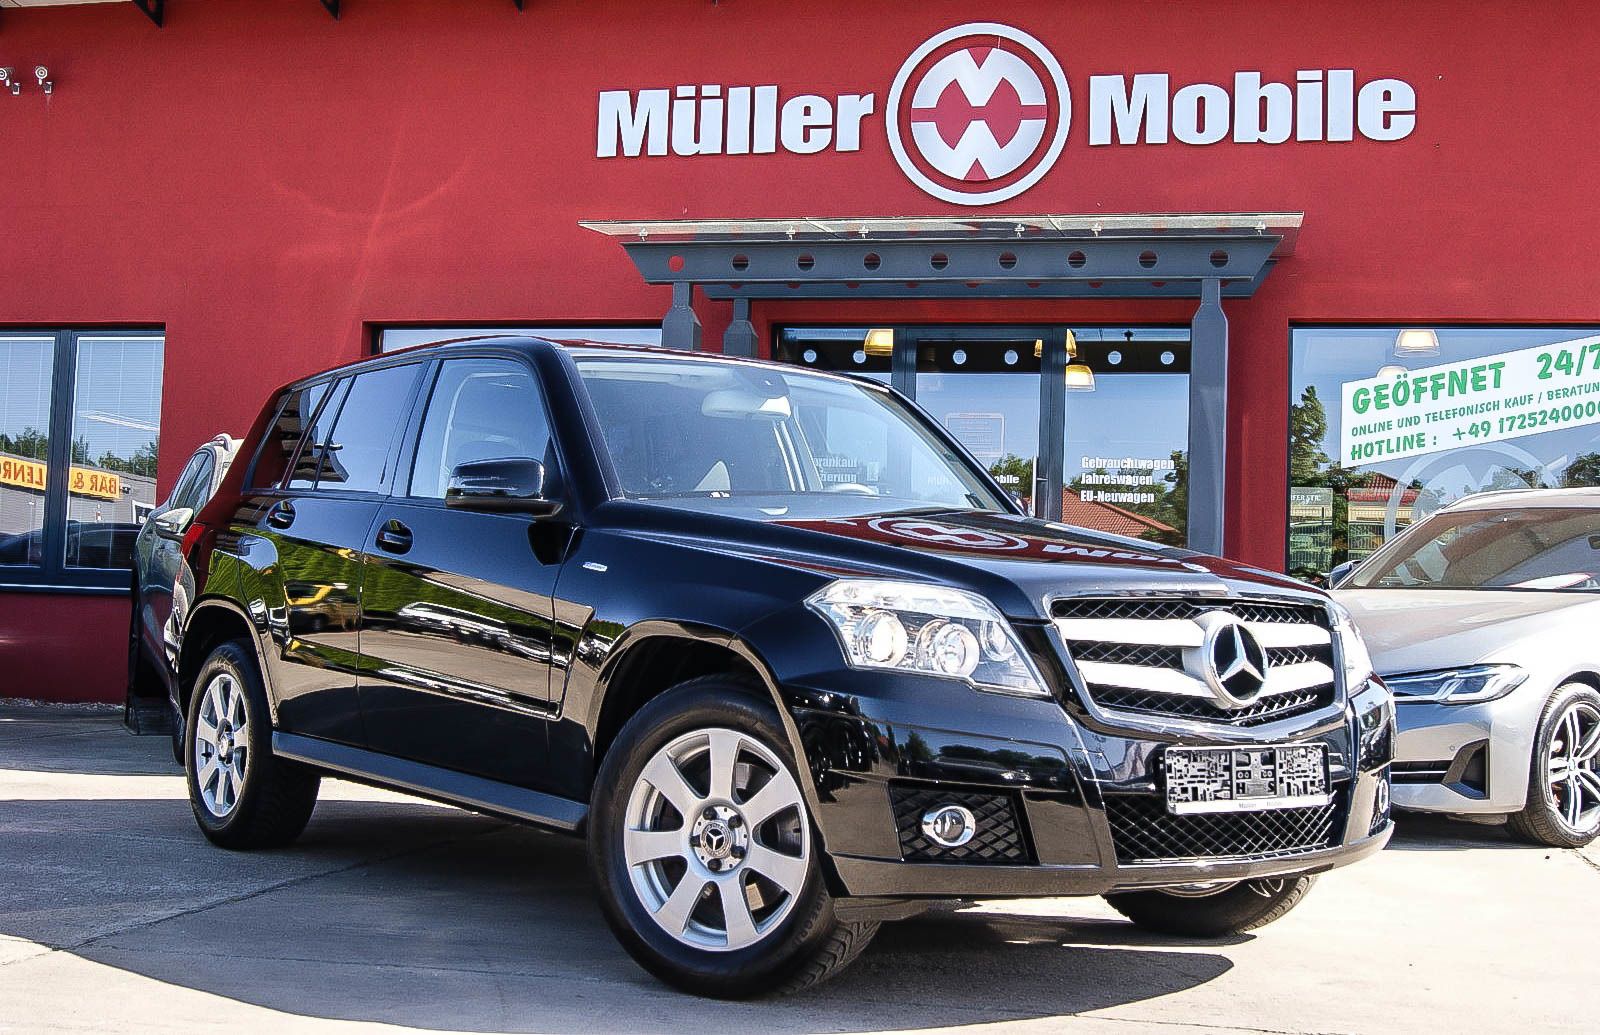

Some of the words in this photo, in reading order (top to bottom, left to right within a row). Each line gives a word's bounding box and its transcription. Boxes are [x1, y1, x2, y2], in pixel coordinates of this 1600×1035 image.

[596, 84, 875, 158] Müller
[1089, 68, 1417, 146] Mobile
[1352, 362, 1505, 414] GEÖFFNET
[1536, 343, 1600, 379] 24/7
[1350, 432, 1426, 460] HOTLINE
[1452, 420, 1492, 441] +49
[1498, 401, 1600, 433] 172524000
[1351, 420, 1393, 437] ONLINE
[1397, 415, 1421, 428] UND
[1424, 400, 1500, 423] TELEFONISCH
[1504, 394, 1534, 410] KAUF
[1081, 473, 1153, 486] Jahreswagen
[1082, 457, 1175, 470] Gebrauchtwagen
[1080, 490, 1155, 504] EU-Neuwagen
